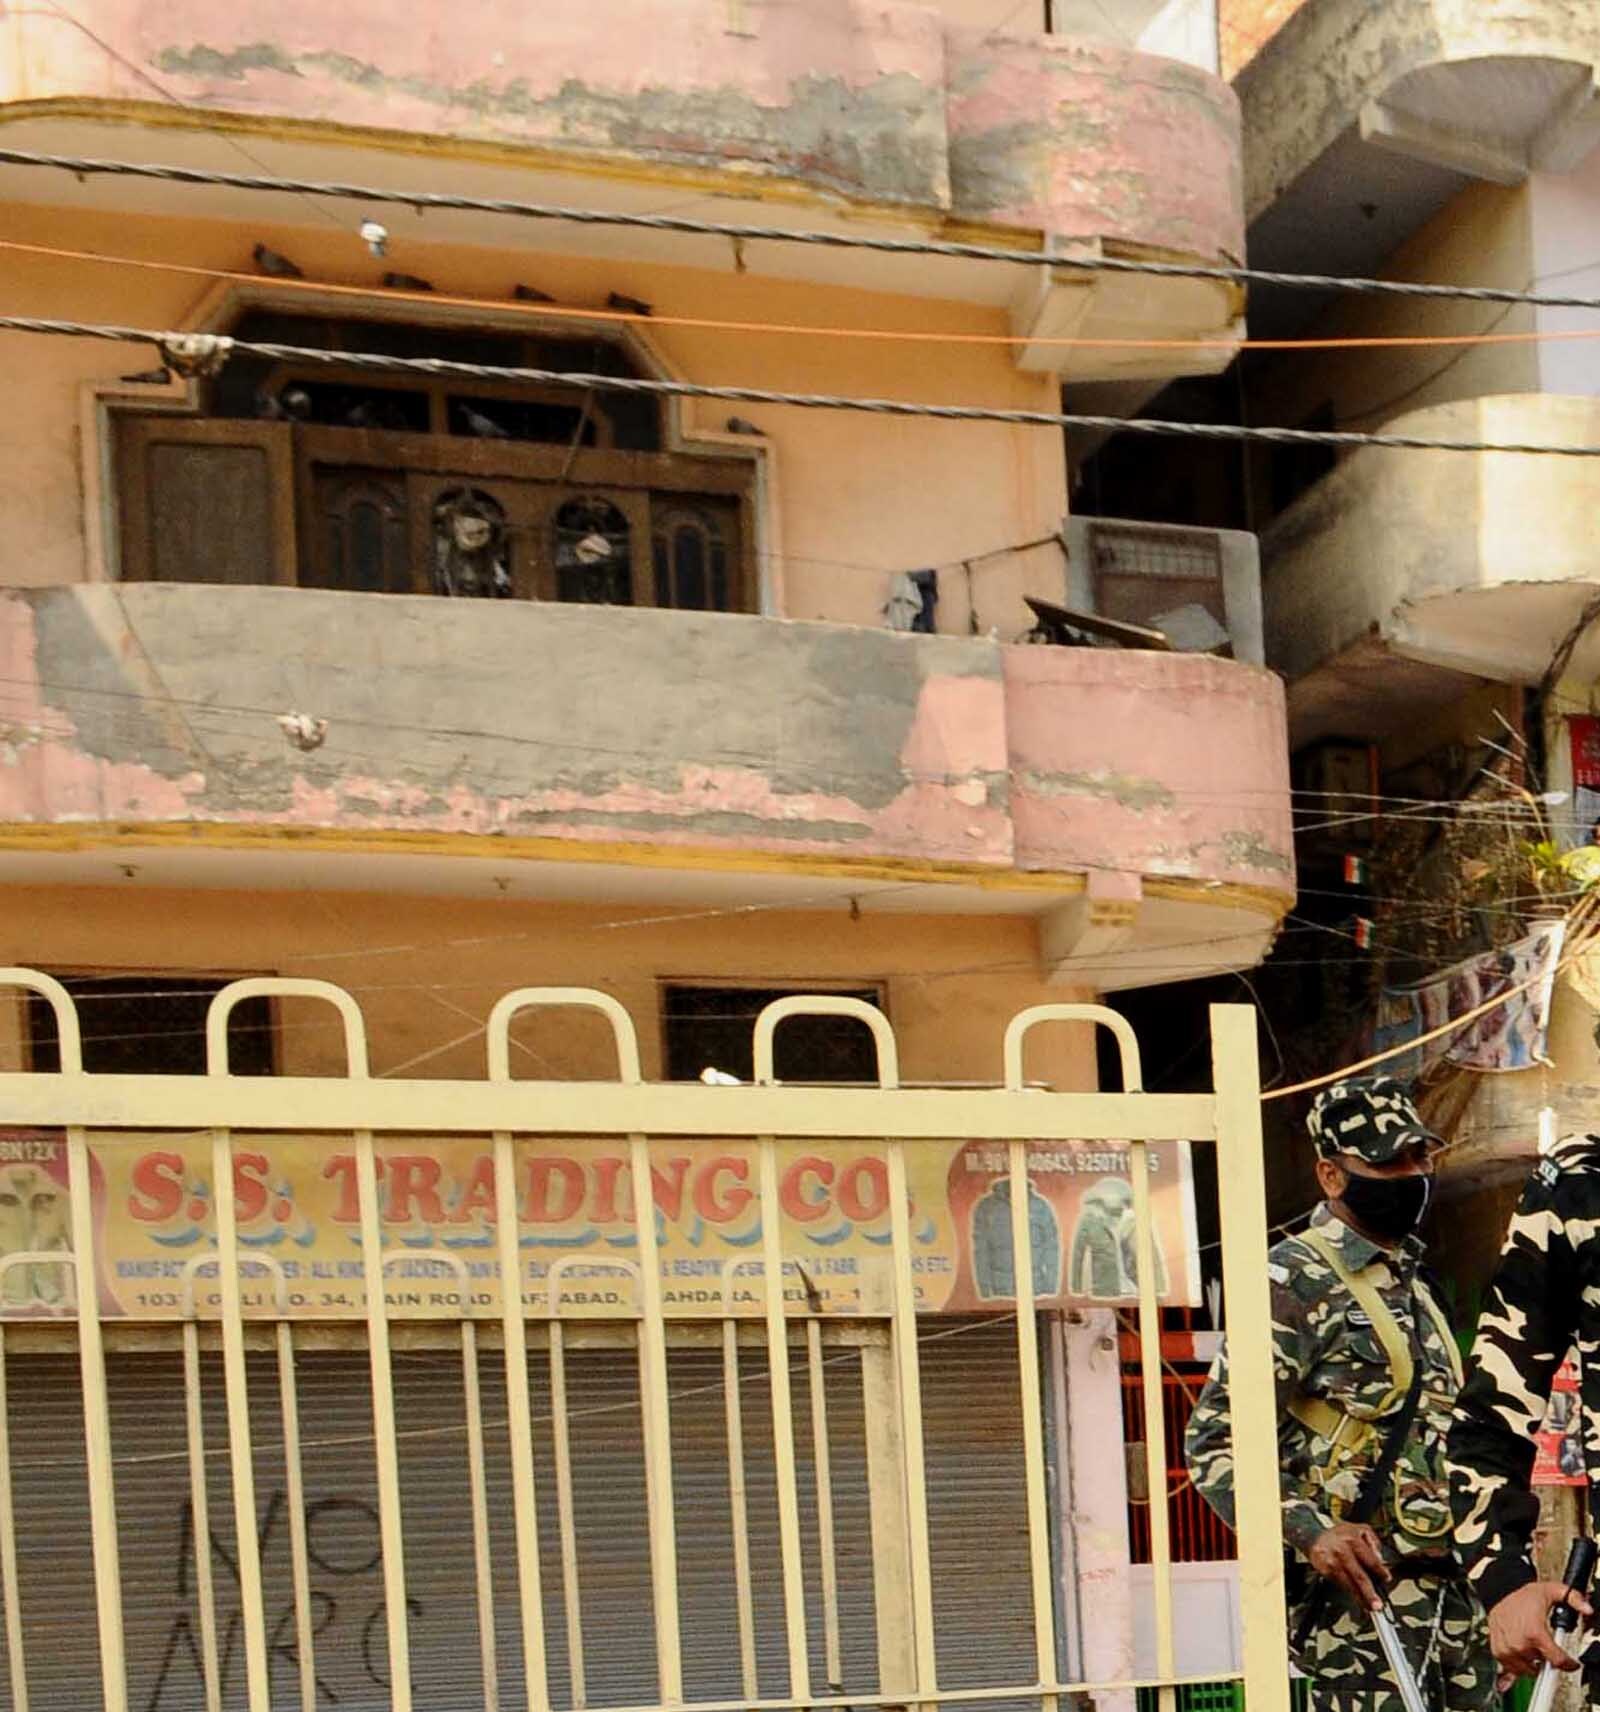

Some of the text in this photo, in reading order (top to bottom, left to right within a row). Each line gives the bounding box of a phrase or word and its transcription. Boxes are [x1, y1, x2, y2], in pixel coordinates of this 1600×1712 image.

[128, 1151, 293, 1223] S.S.
[321, 1155, 755, 1224] TRADING
[206, 1292, 265, 1307] GLI
[320, 1291, 356, 1308] 34,
[361, 1291, 441, 1307] AIN
[177, 1488, 384, 1598] NO
